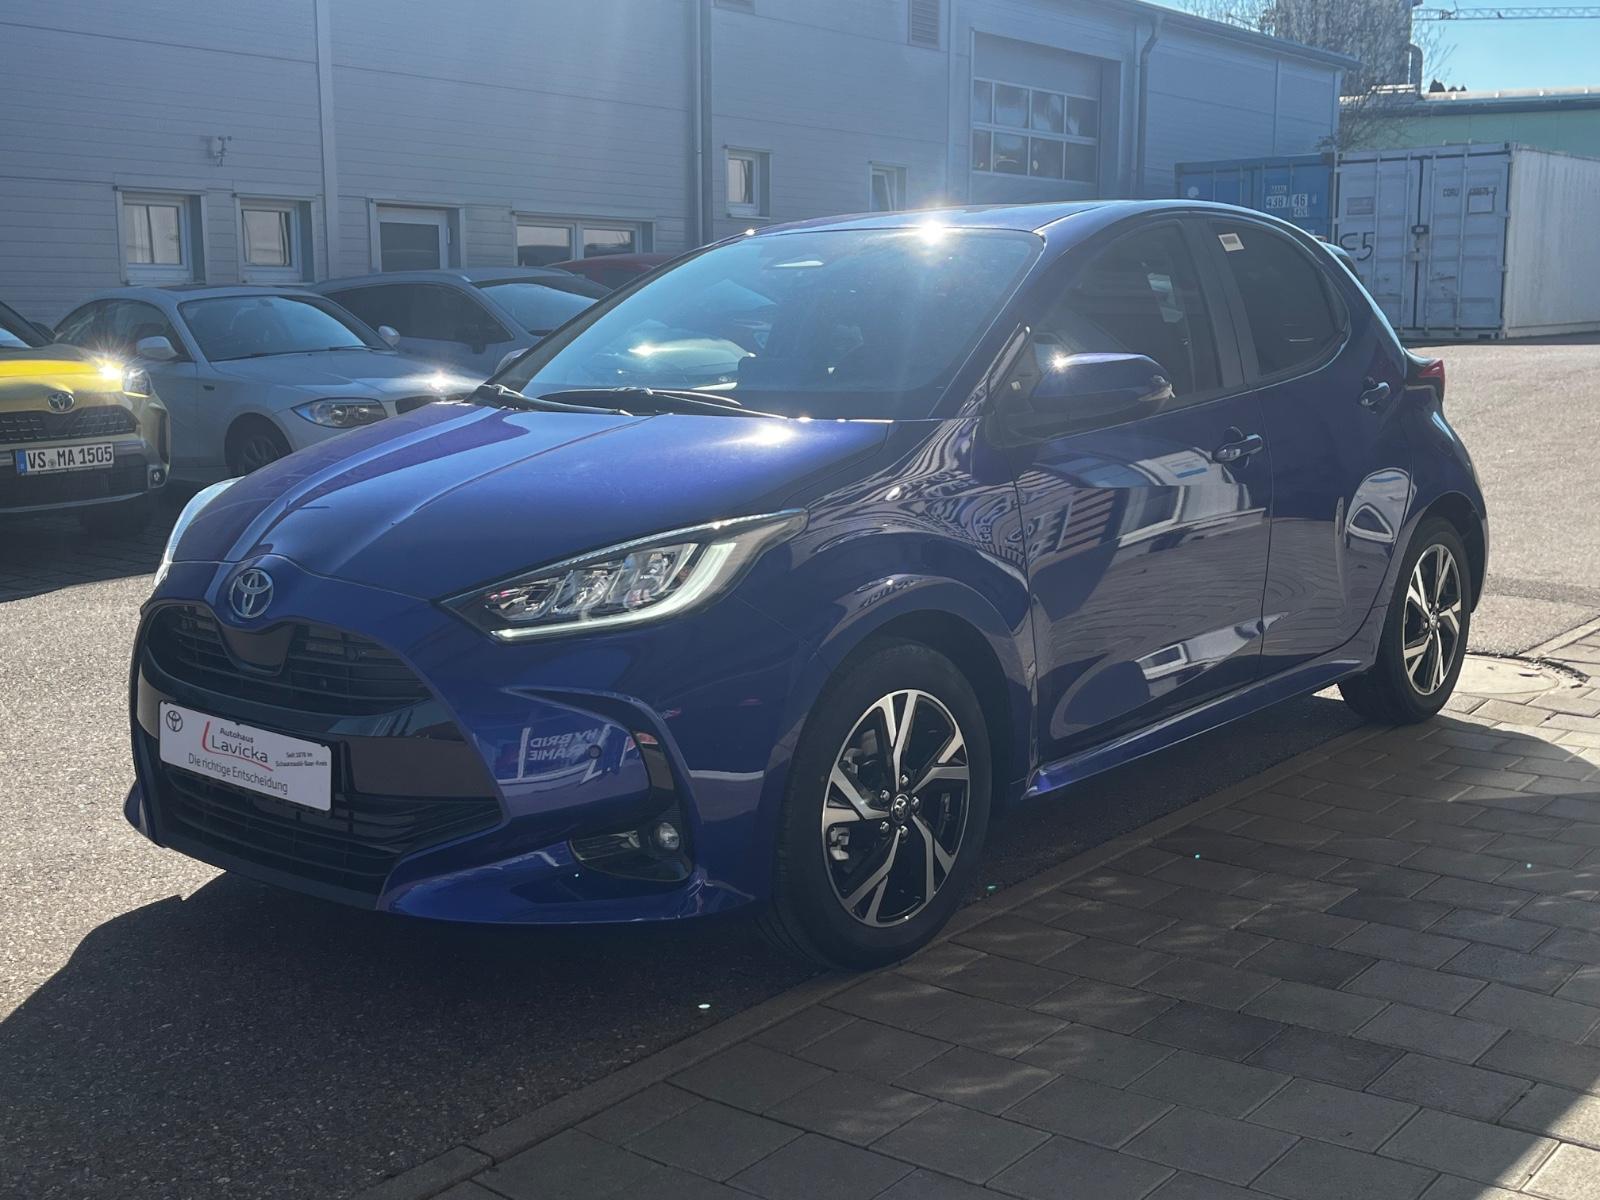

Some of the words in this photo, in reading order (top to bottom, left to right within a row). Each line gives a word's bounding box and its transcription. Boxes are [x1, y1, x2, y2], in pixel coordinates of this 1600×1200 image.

[27, 451, 47, 470] VS
[57, 448, 76, 467] MA
[79, 445, 113, 465] 1505
[211, 734, 269, 764] Lavicka
[219, 728, 254, 744] Autohaus
[188, 752, 201, 769] Die
[202, 758, 232, 778] richtige
[232, 765, 289, 796] Entscheidung
